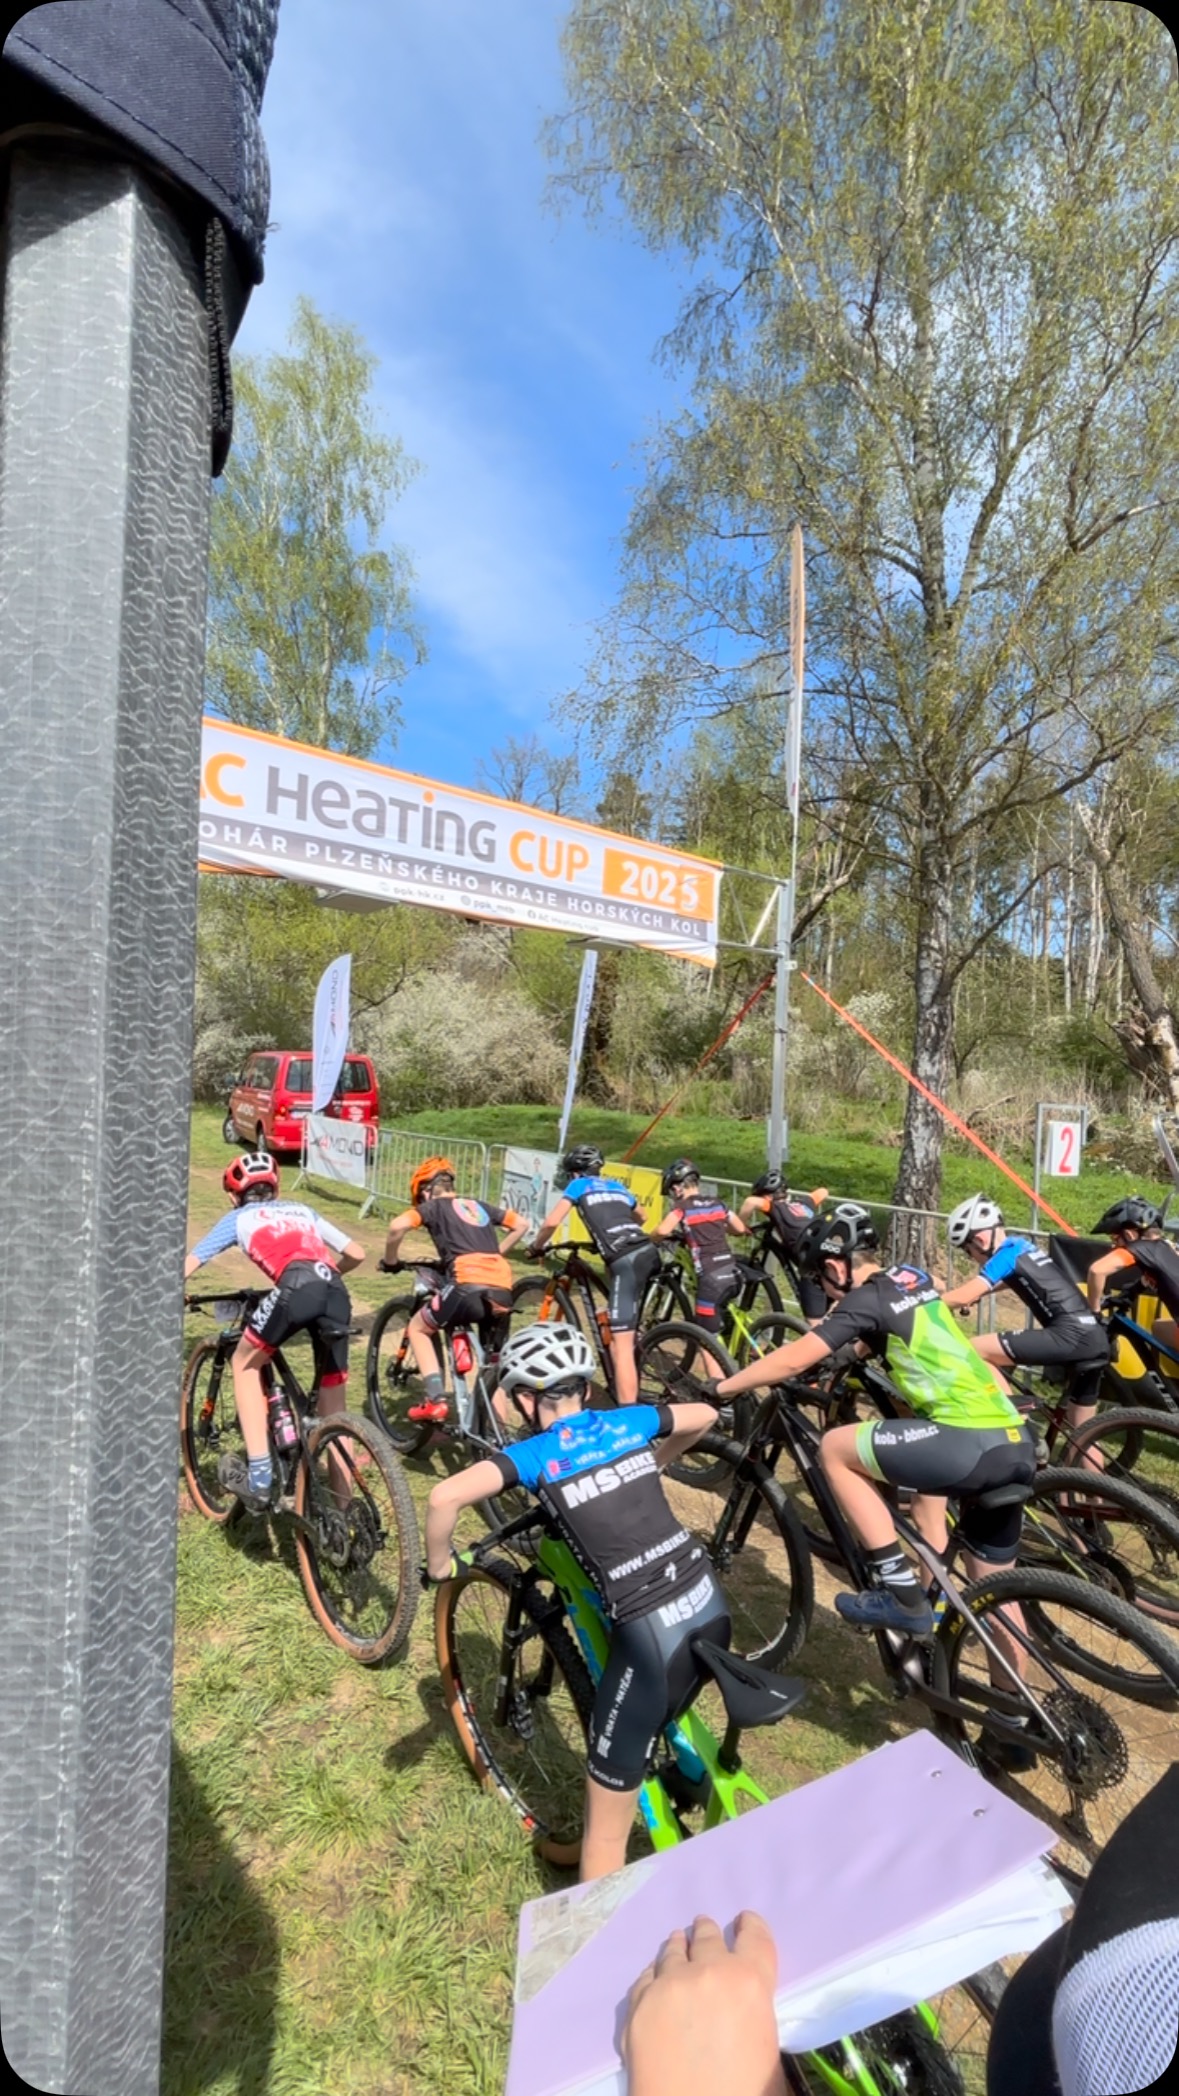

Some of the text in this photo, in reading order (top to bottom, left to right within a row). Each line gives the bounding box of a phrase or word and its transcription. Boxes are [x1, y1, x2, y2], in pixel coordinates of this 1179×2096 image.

[199, 819, 701, 937] OHÁR PLZEŇSKÉHO KRAJE HORSKÝCH KOL
[200, 752, 246, 808] C
[509, 830, 590, 883] CUP
[620, 860, 699, 912] 2025
[1059, 1126, 1073, 1172] 2
